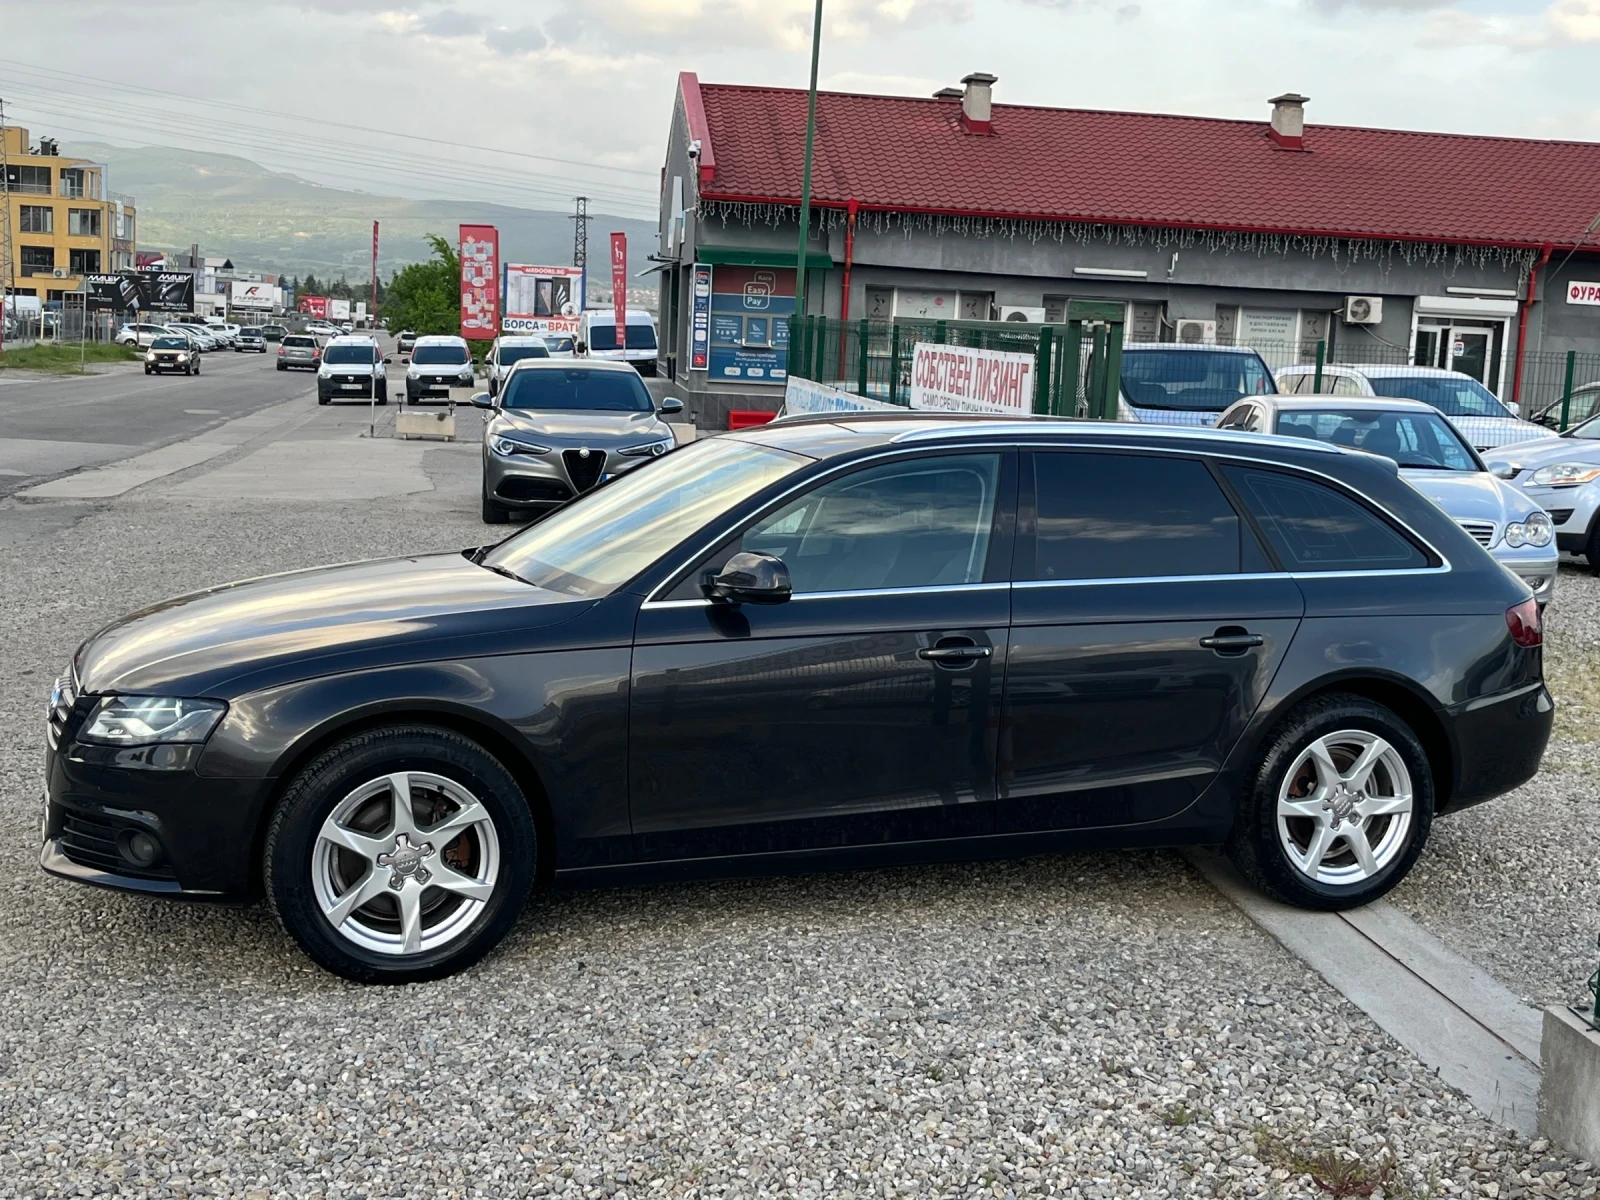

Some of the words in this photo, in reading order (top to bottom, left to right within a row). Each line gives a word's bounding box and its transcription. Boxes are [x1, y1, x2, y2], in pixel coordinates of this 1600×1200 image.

[747, 286, 766, 295] Easy
[747, 297, 762, 306] Pay
[504, 320, 539, 330] БОРСА
[916, 350, 972, 399] СОБСТВЕН
[973, 358, 1029, 408] ЛИЗИНГ
[922, 392, 938, 406] САМО
